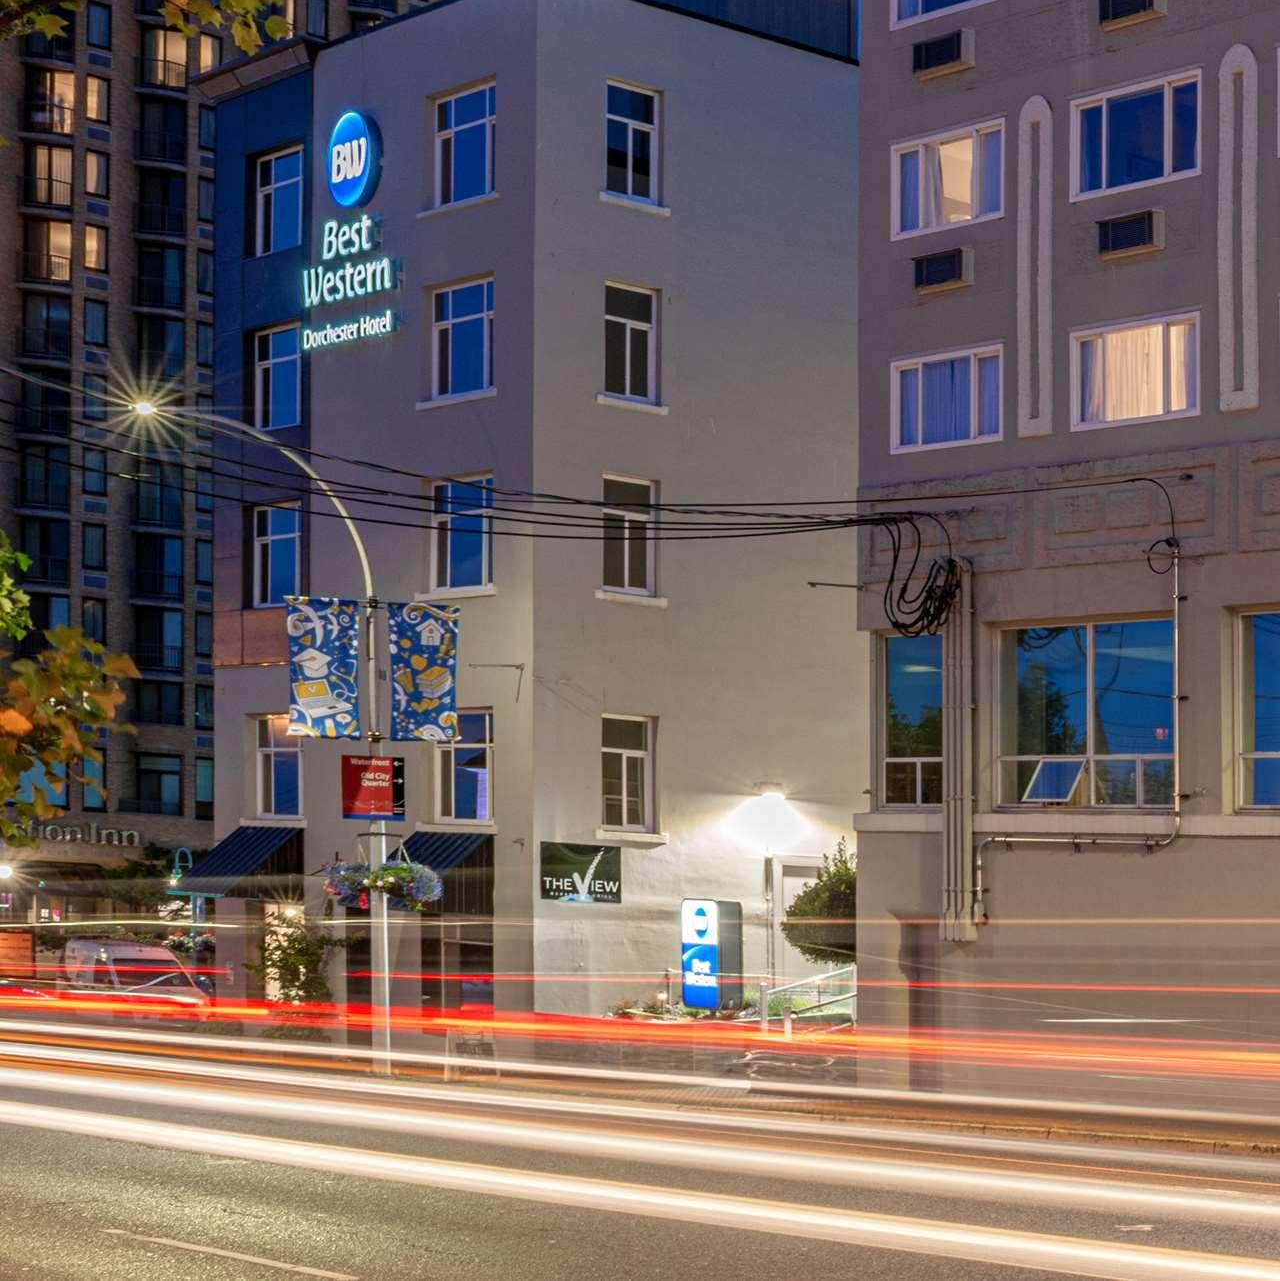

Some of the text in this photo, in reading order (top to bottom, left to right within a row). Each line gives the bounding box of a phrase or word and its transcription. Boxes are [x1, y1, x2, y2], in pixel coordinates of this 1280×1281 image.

[331, 136, 367, 184] BW
[322, 214, 372, 260] Best
[303, 257, 392, 307] Western
[303, 310, 392, 349] Dorchester Hotel
[350, 758, 390, 767] Waterfront
[360, 772, 390, 782] Old City
[360, 779, 390, 788] Quarter
[89, 822, 141, 847] Inn
[543, 877, 574, 891] THE
